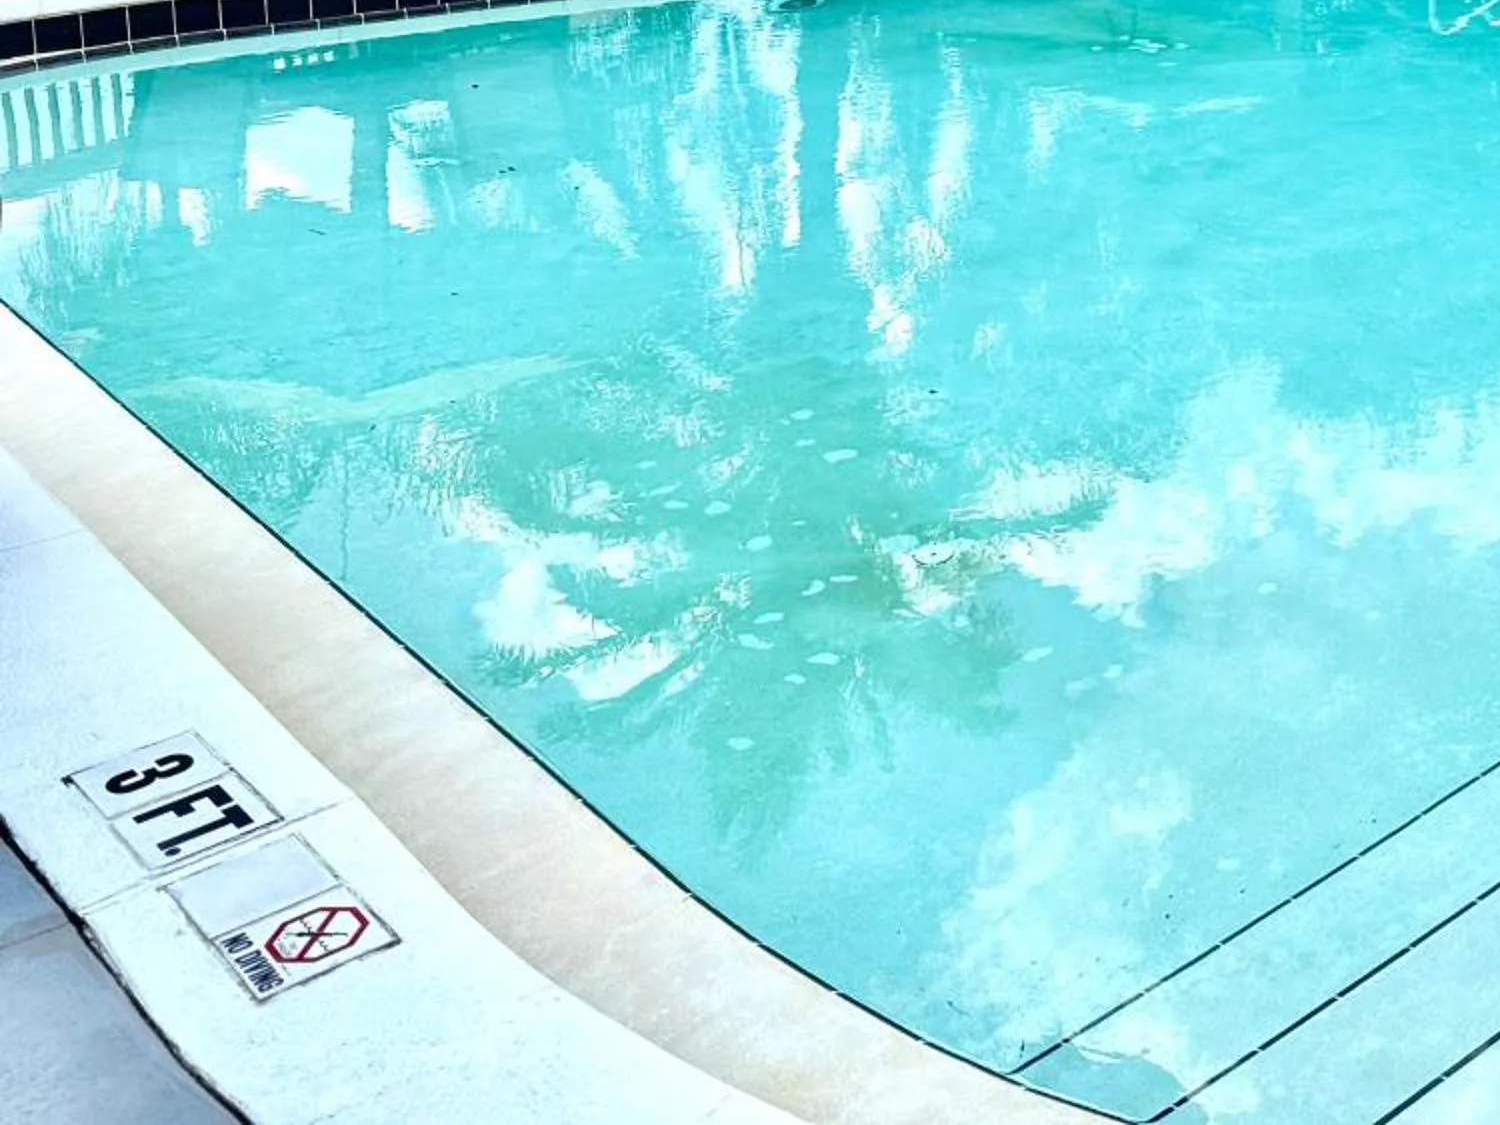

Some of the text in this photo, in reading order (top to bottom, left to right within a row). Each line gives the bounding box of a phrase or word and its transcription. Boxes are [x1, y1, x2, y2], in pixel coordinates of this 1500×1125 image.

[105, 753, 254, 856] 3 FT.
[220, 932, 285, 993] NO DIVING
